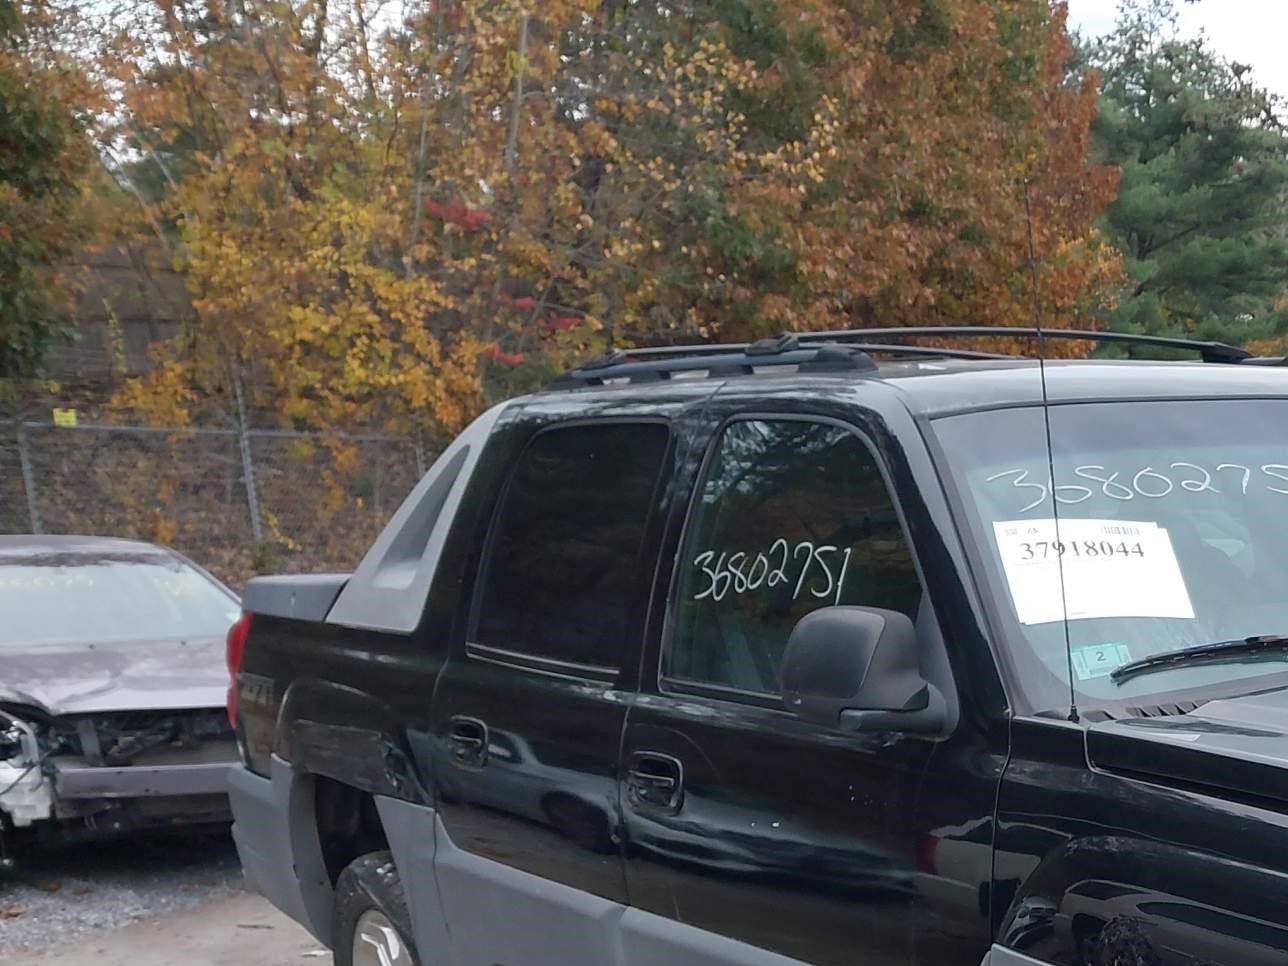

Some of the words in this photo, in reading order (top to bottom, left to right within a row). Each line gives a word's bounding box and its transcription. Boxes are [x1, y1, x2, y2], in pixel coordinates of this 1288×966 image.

[1020, 540, 1145, 560] 37918044
[694, 539, 851, 606] 36802751
[1096, 651, 1106, 662] 2
